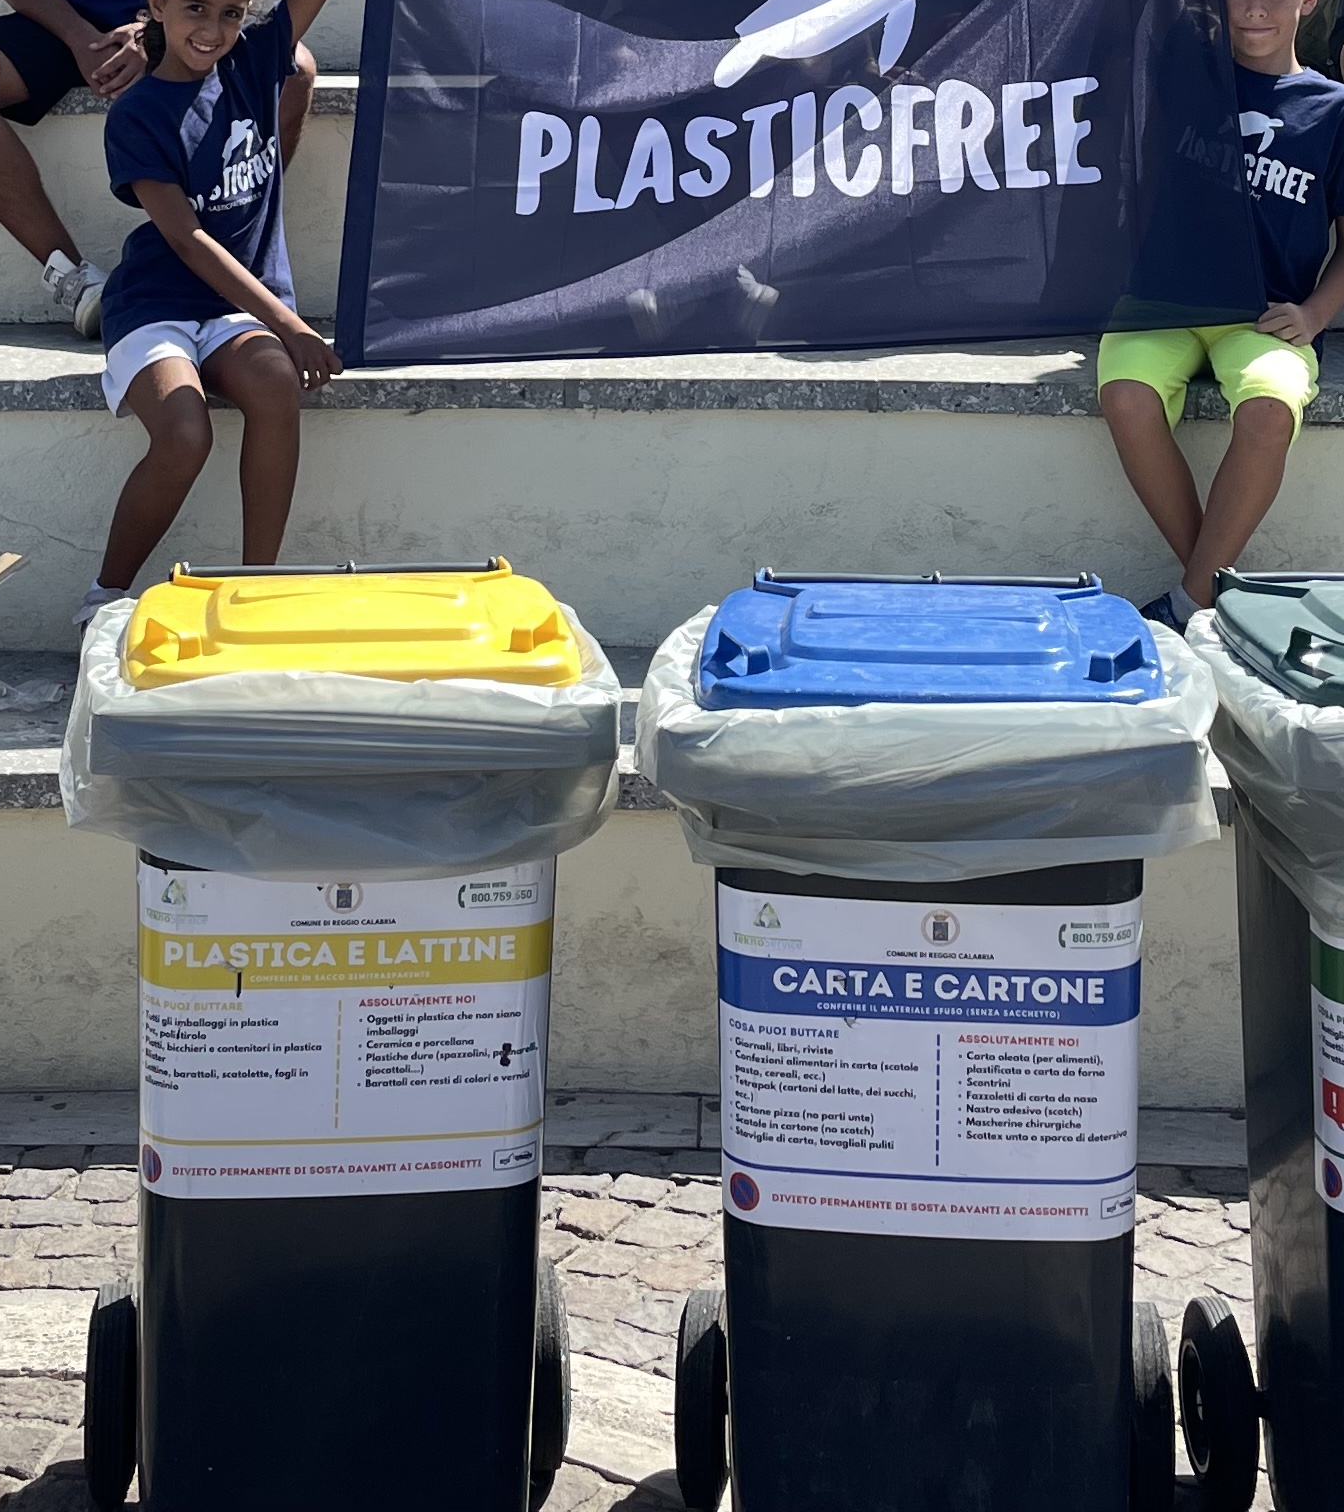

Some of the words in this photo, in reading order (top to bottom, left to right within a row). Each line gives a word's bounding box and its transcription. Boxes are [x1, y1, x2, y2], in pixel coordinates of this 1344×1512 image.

[514, 76, 1103, 218] PLASTICFREE
[471, 889, 533, 903] 800.759.650
[290, 919, 322, 928] COMUNE
[323, 919, 331, 927] DI
[332, 919, 359, 927] REGGIO
[361, 917, 397, 926] CALABRIA
[1072, 928, 1132, 943] 800.759.650
[163, 940, 333, 970] PLASTICA
[348, 939, 366, 965] E
[376, 934, 516, 965] LATTINE
[886, 950, 918, 958] COMUNE
[919, 951, 928, 959] DI
[928, 951, 957, 959] REGGIO
[958, 952, 995, 961] CALABRIA
[772, 965, 895, 999] CARTA
[905, 972, 923, 999] E
[933, 972, 1106, 1006] CARTONE
[358, 995, 453, 1007] ASSOLUTAMENTE
[455, 995, 476, 1005] NO!
[366, 1013, 404, 1026] Oggetti
[417, 1012, 455, 1024] plastica
[456, 1010, 473, 1021] che
[475, 1010, 494, 1020] non
[496, 1009, 522, 1019] siano
[816, 1001, 867, 1012] CONFERIRE
[869, 1004, 878, 1012] IL
[880, 1005, 930, 1015] MATERIALE
[933, 1007, 963, 1016] SFUSO
[965, 1007, 1001, 1017] (SENZA
[1003, 1008, 1061, 1020] SACCHETTO)
[174, 1018, 227, 1030] imballaggi
[729, 1017, 756, 1034] COSA
[758, 1025, 788, 1036] PUOI
[790, 1027, 840, 1039] BUTTARE
[366, 1026, 419, 1038] imballaggi
[366, 1039, 413, 1049] Ceramica
[423, 1037, 475, 1049] porcellana
[958, 1035, 1055, 1046] ASSOLUTAMENTE
[1058, 1036, 1080, 1047] NO!
[734, 1049, 784, 1066] Confezioni
[786, 1056, 838, 1069] alimentari
[851, 1060, 878, 1070] carta
[880, 1060, 919, 1073] (scatole
[966, 1051, 996, 1062] Carta
[998, 1052, 1031, 1063] oleata
[1032, 1053, 1053, 1064] (per
[1055, 1054, 1104, 1065] alimenti),
[966, 1065, 1022, 1077] plastificata
[1033, 1067, 1060, 1077] carta
[1062, 1068, 1076, 1077] da
[1077, 1068, 1106, 1077] forno
[966, 1078, 1011, 1088] Scontrini
[966, 1091, 1015, 1102] Fazzoletti
[1028, 1093, 1056, 1103] carta
[1057, 1093, 1071, 1103] da
[1073, 1095, 1098, 1103] naso
[966, 1104, 1000, 1115] Nastro
[1002, 1105, 1042, 1116] adesivo
[1044, 1106, 1083, 1118] (scotch)
[965, 1117, 1023, 1128] Mascherine
[1025, 1118, 1082, 1131] chirurgiche
[966, 1131, 1003, 1141] Scottex
[1005, 1133, 1029, 1141] unto
[1039, 1134, 1074, 1144] sporco
[1087, 1129, 1128, 1143] detersivo
[172, 1166, 218, 1177] DIVIETO
[219, 1166, 292, 1177] PERMANENTE
[294, 1165, 307, 1176] DI
[309, 1164, 345, 1175] SOSTA
[346, 1162, 398, 1174] DAVANTI
[398, 1162, 413, 1172] AI
[414, 1158, 483, 1171] CASSONETTI
[771, 1192, 818, 1205] DIVIETO
[820, 1197, 893, 1211] PERMANENTE
[895, 1200, 909, 1212] DI
[911, 1201, 949, 1213] SOSTA
[950, 1204, 1002, 1216] DAVANTI
[1003, 1205, 1017, 1216] AI
[1019, 1205, 1090, 1217] CASSONETTI
